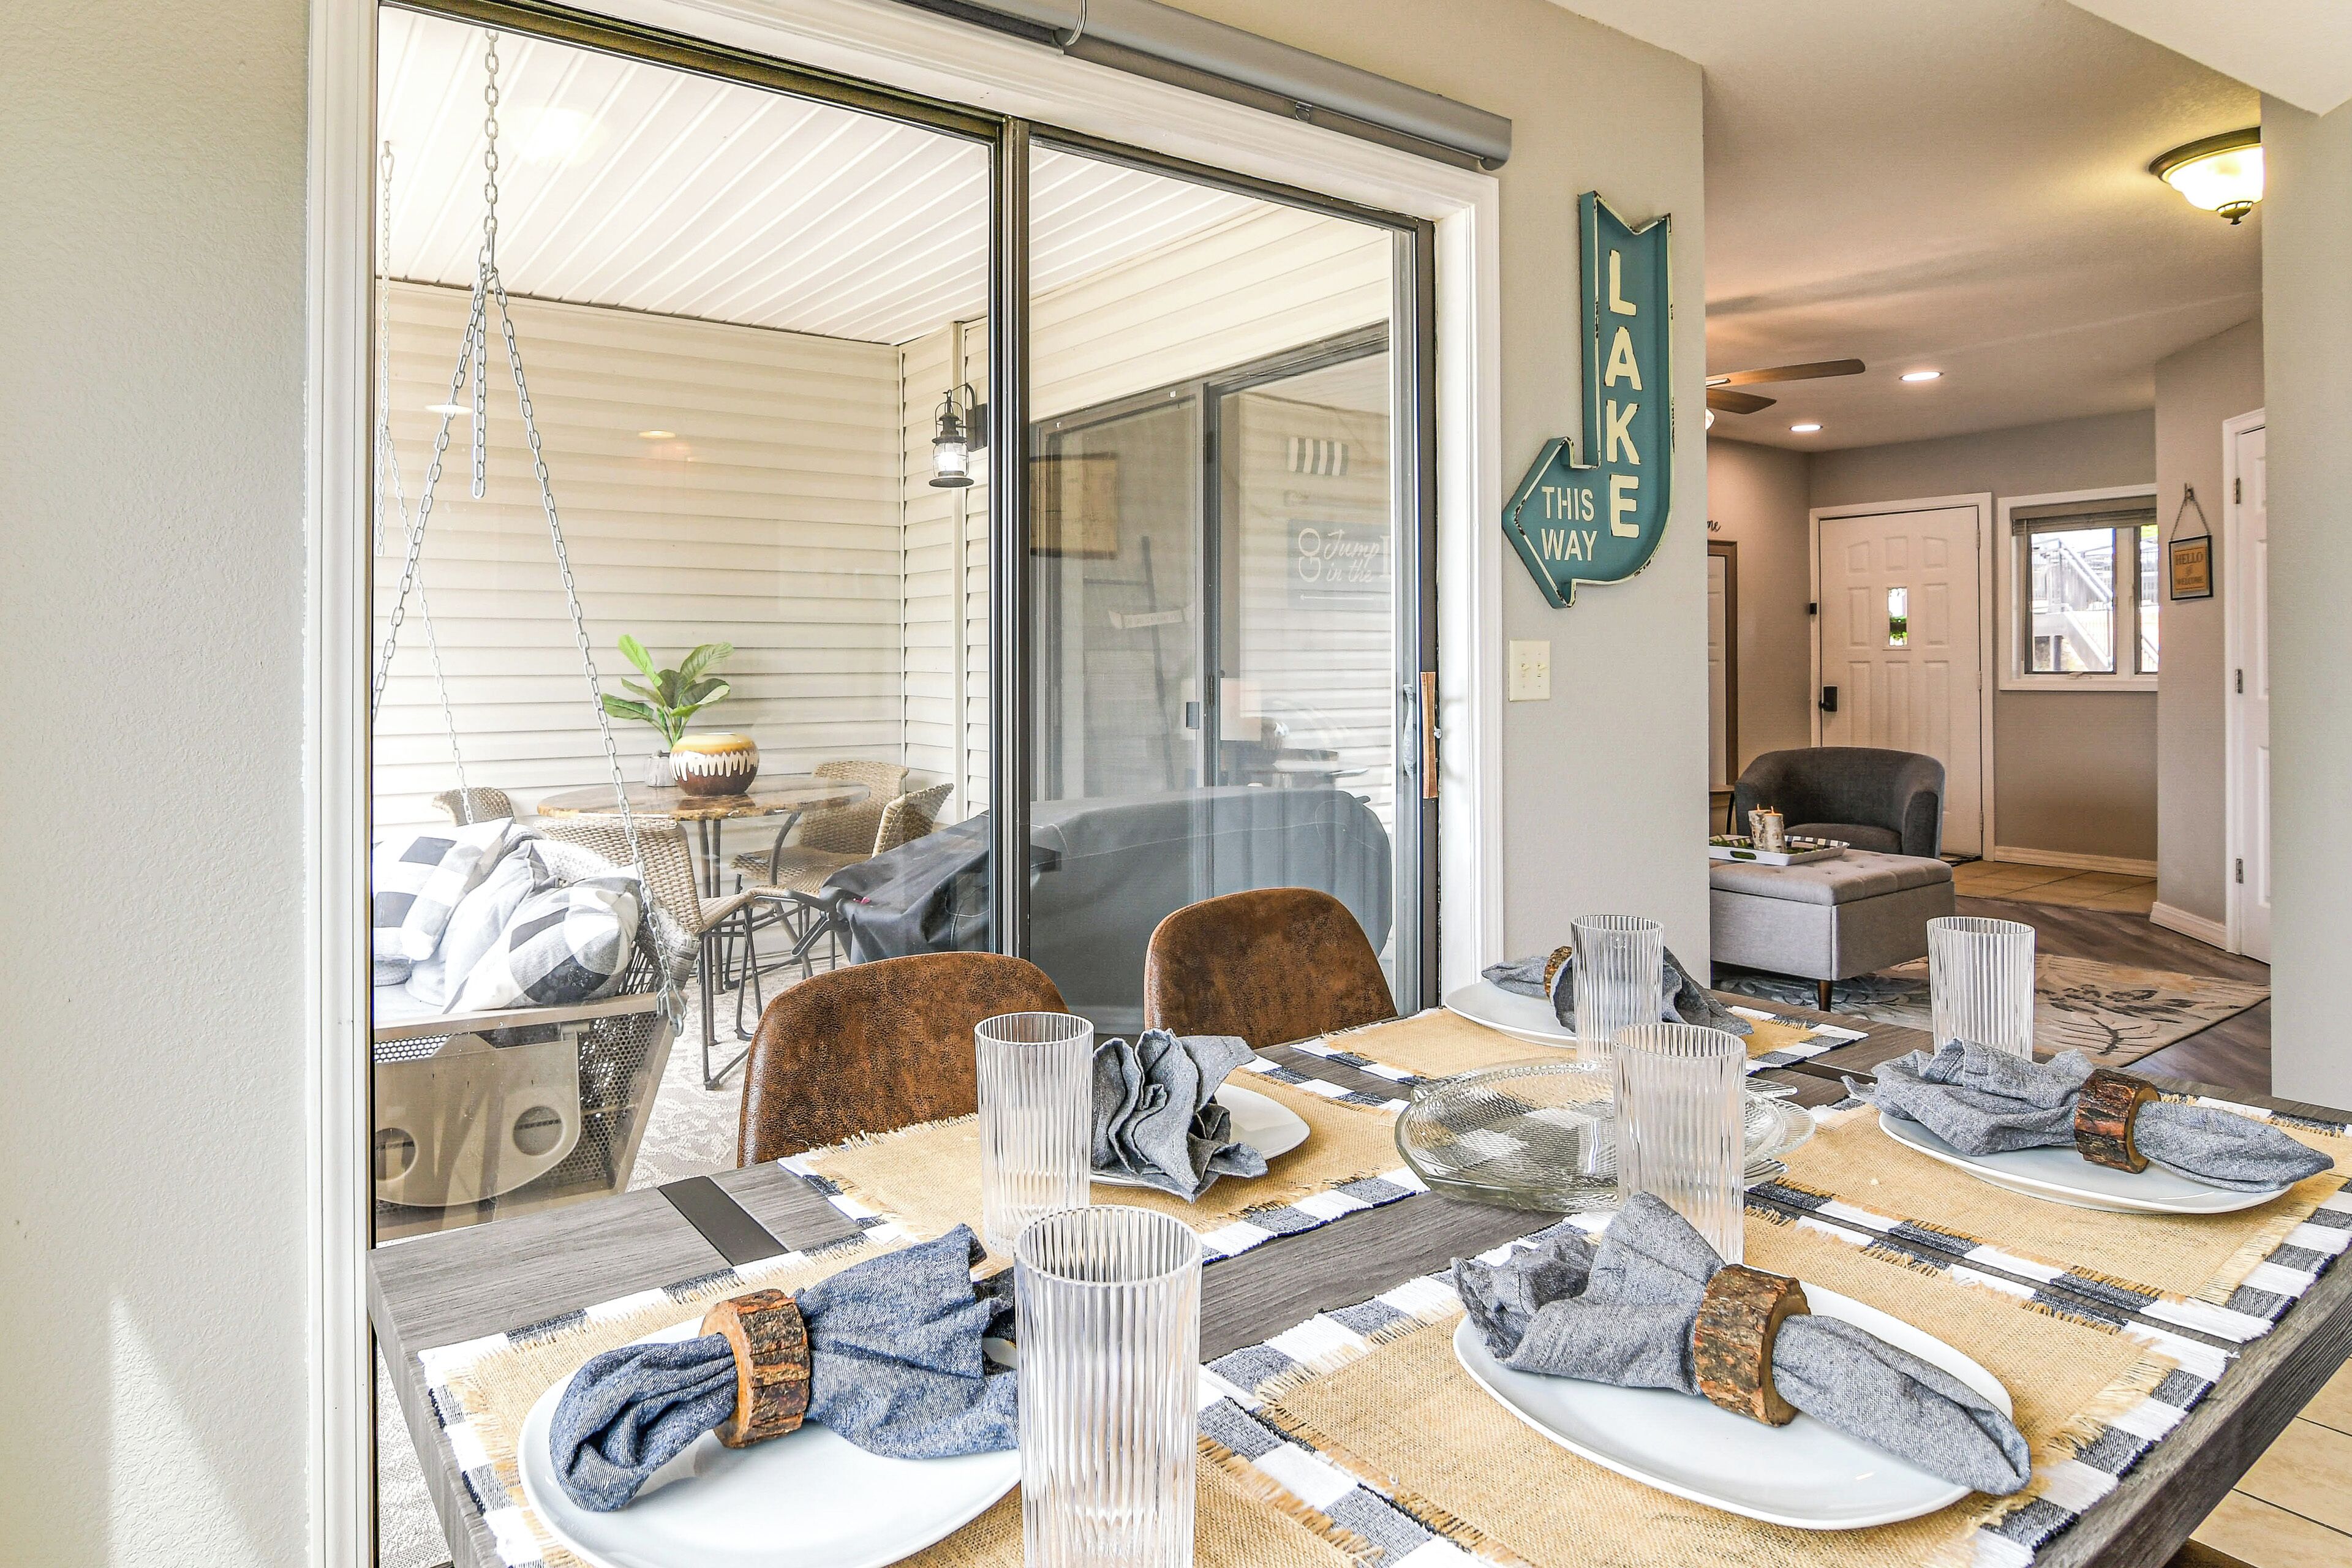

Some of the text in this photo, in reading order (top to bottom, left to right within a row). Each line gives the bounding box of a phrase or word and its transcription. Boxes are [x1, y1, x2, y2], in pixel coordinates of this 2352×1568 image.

[1604, 249, 1642, 538] LAKE
[1541, 486, 1595, 522] THIS
[1324, 529, 1381, 569] Jump
[1541, 528, 1598, 562] WAY
[2175, 551, 2203, 565] HELLO
[1326, 559, 1373, 583] in the
